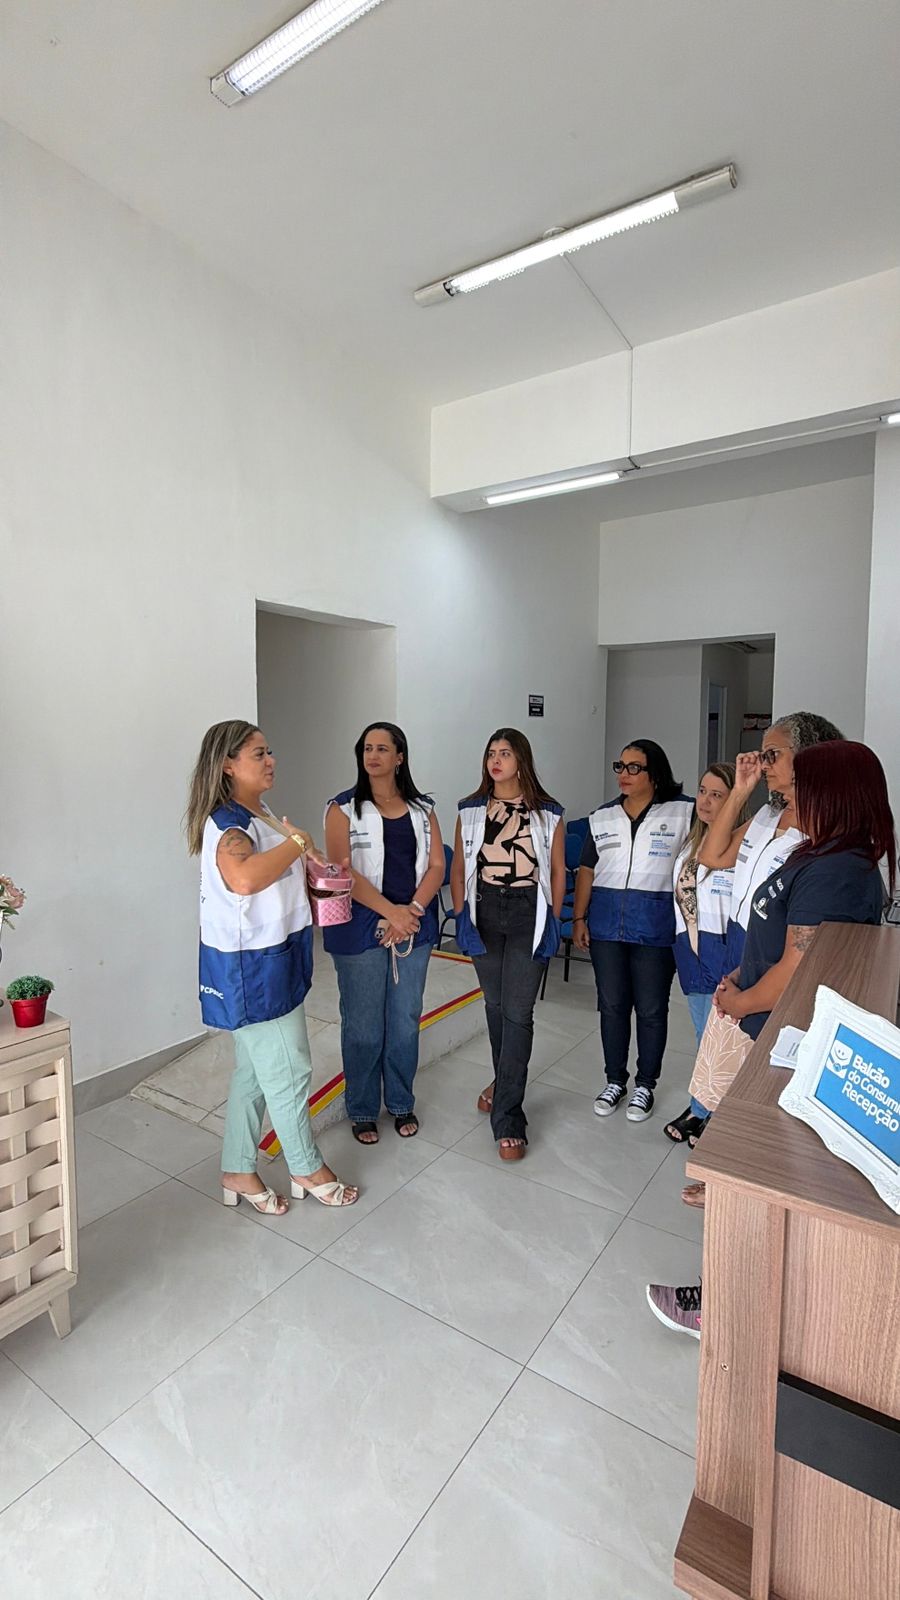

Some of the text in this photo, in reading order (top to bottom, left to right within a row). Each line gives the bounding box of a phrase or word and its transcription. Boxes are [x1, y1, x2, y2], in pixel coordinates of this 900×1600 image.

[848, 1070, 900, 1115] do Consumi
[852, 1054, 890, 1088] Balcão
[841, 1080, 899, 1132] Recepção
